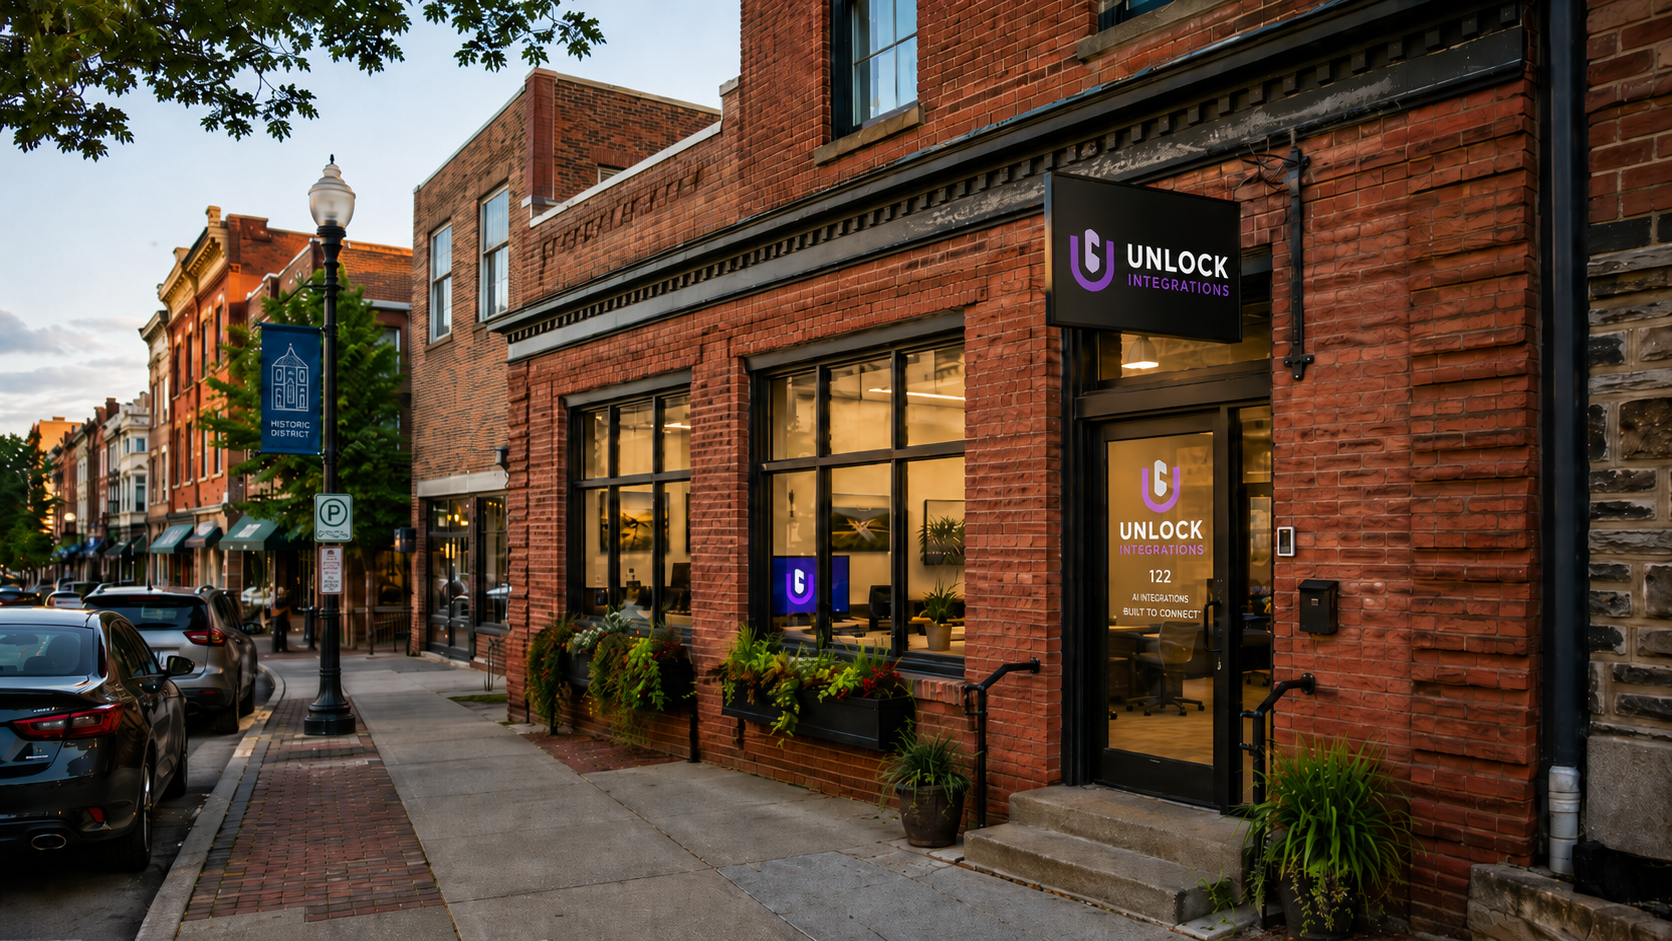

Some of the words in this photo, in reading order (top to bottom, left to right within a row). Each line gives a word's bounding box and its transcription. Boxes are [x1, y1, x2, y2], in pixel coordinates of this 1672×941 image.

[1127, 243, 1229, 279] UNLOCK
[1128, 273, 1229, 297] INTEGRATIONS
[271, 420, 311, 429] HISTORIC
[271, 429, 310, 438] DISTRICT
[328, 504, 341, 521] P
[1119, 520, 1203, 540] UNLOCK
[1119, 544, 1204, 555] INTEGRATIONS
[1149, 569, 1172, 583] 122
[1132, 593, 1139, 601] AI
[1140, 593, 1189, 604] INTEGRATIONS
[1146, 608, 1158, 617] TO
